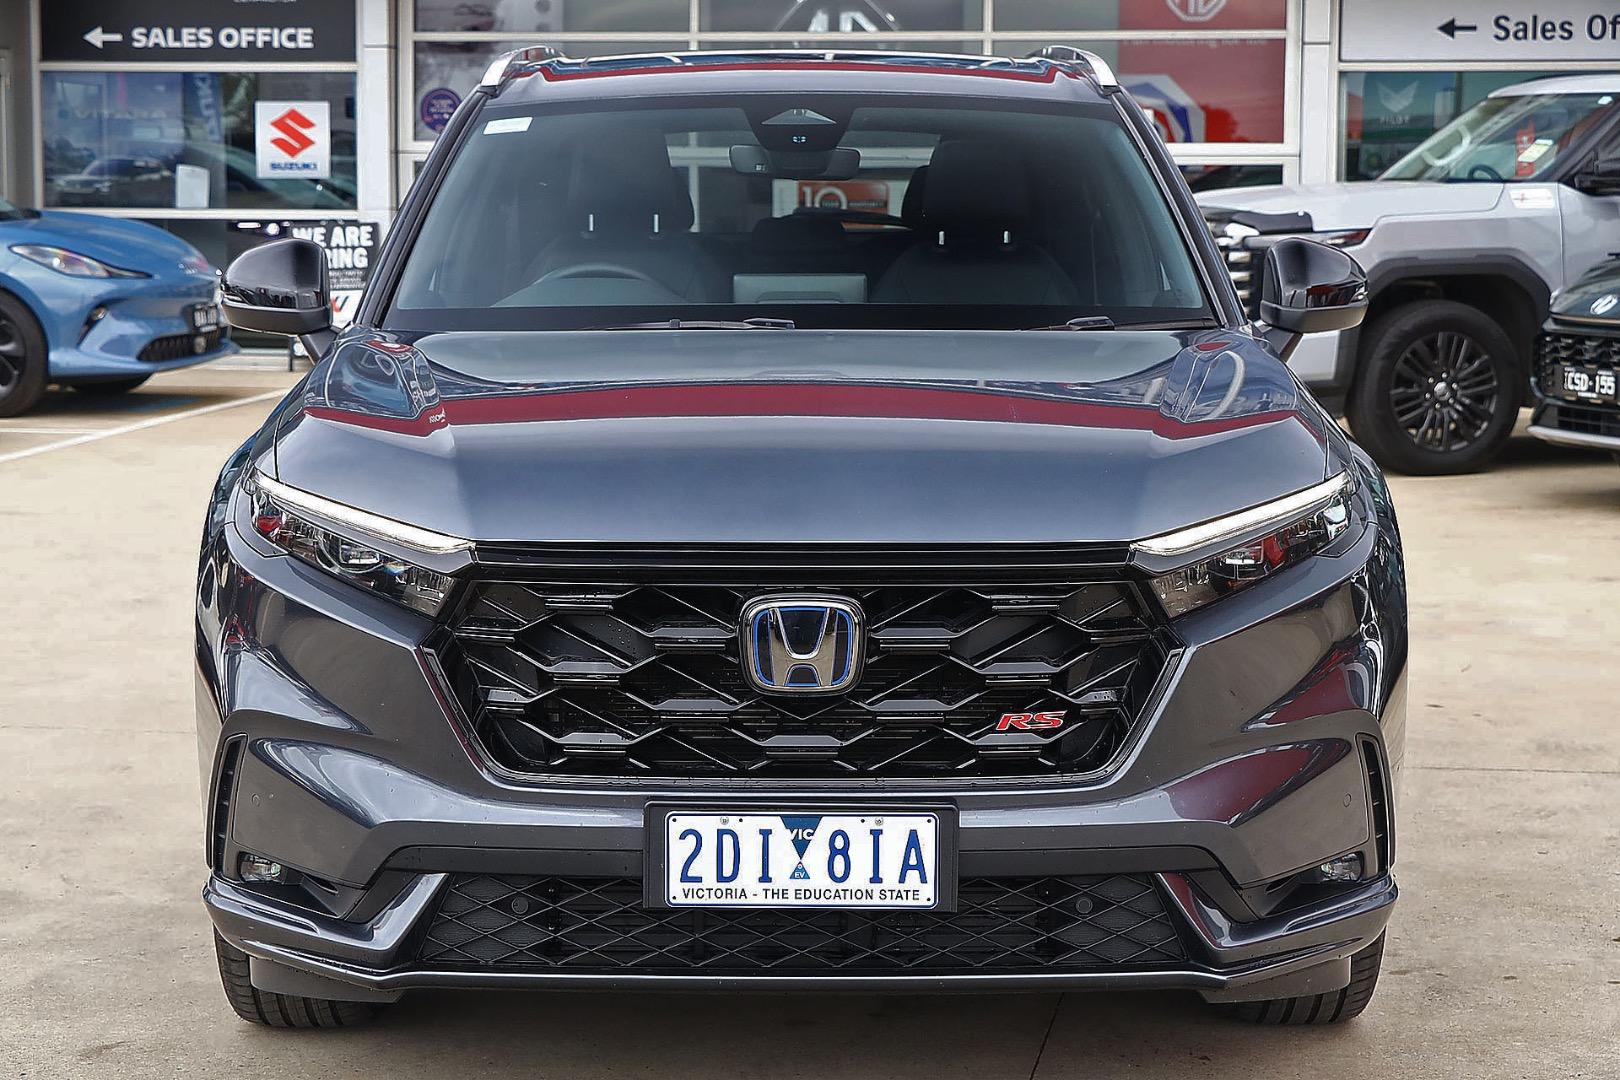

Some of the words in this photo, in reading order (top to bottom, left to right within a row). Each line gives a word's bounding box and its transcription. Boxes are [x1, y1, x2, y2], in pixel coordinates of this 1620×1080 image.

[131, 27, 213, 49] SALES
[218, 27, 315, 49] OFFICE
[1493, 15, 1574, 41] Sales
[270, 163, 317, 171] SUZUKI
[330, 225, 374, 248] ARE
[996, 710, 1068, 731] RS
[788, 828, 815, 841] VIC
[678, 828, 773, 884] 2DI
[827, 828, 928, 884] 8IA
[794, 871, 806, 879] EV
[682, 887, 748, 900] VICTORIA
[762, 887, 789, 900] THE
[794, 888, 874, 901] EDUCATION
[878, 888, 920, 901] STATE
